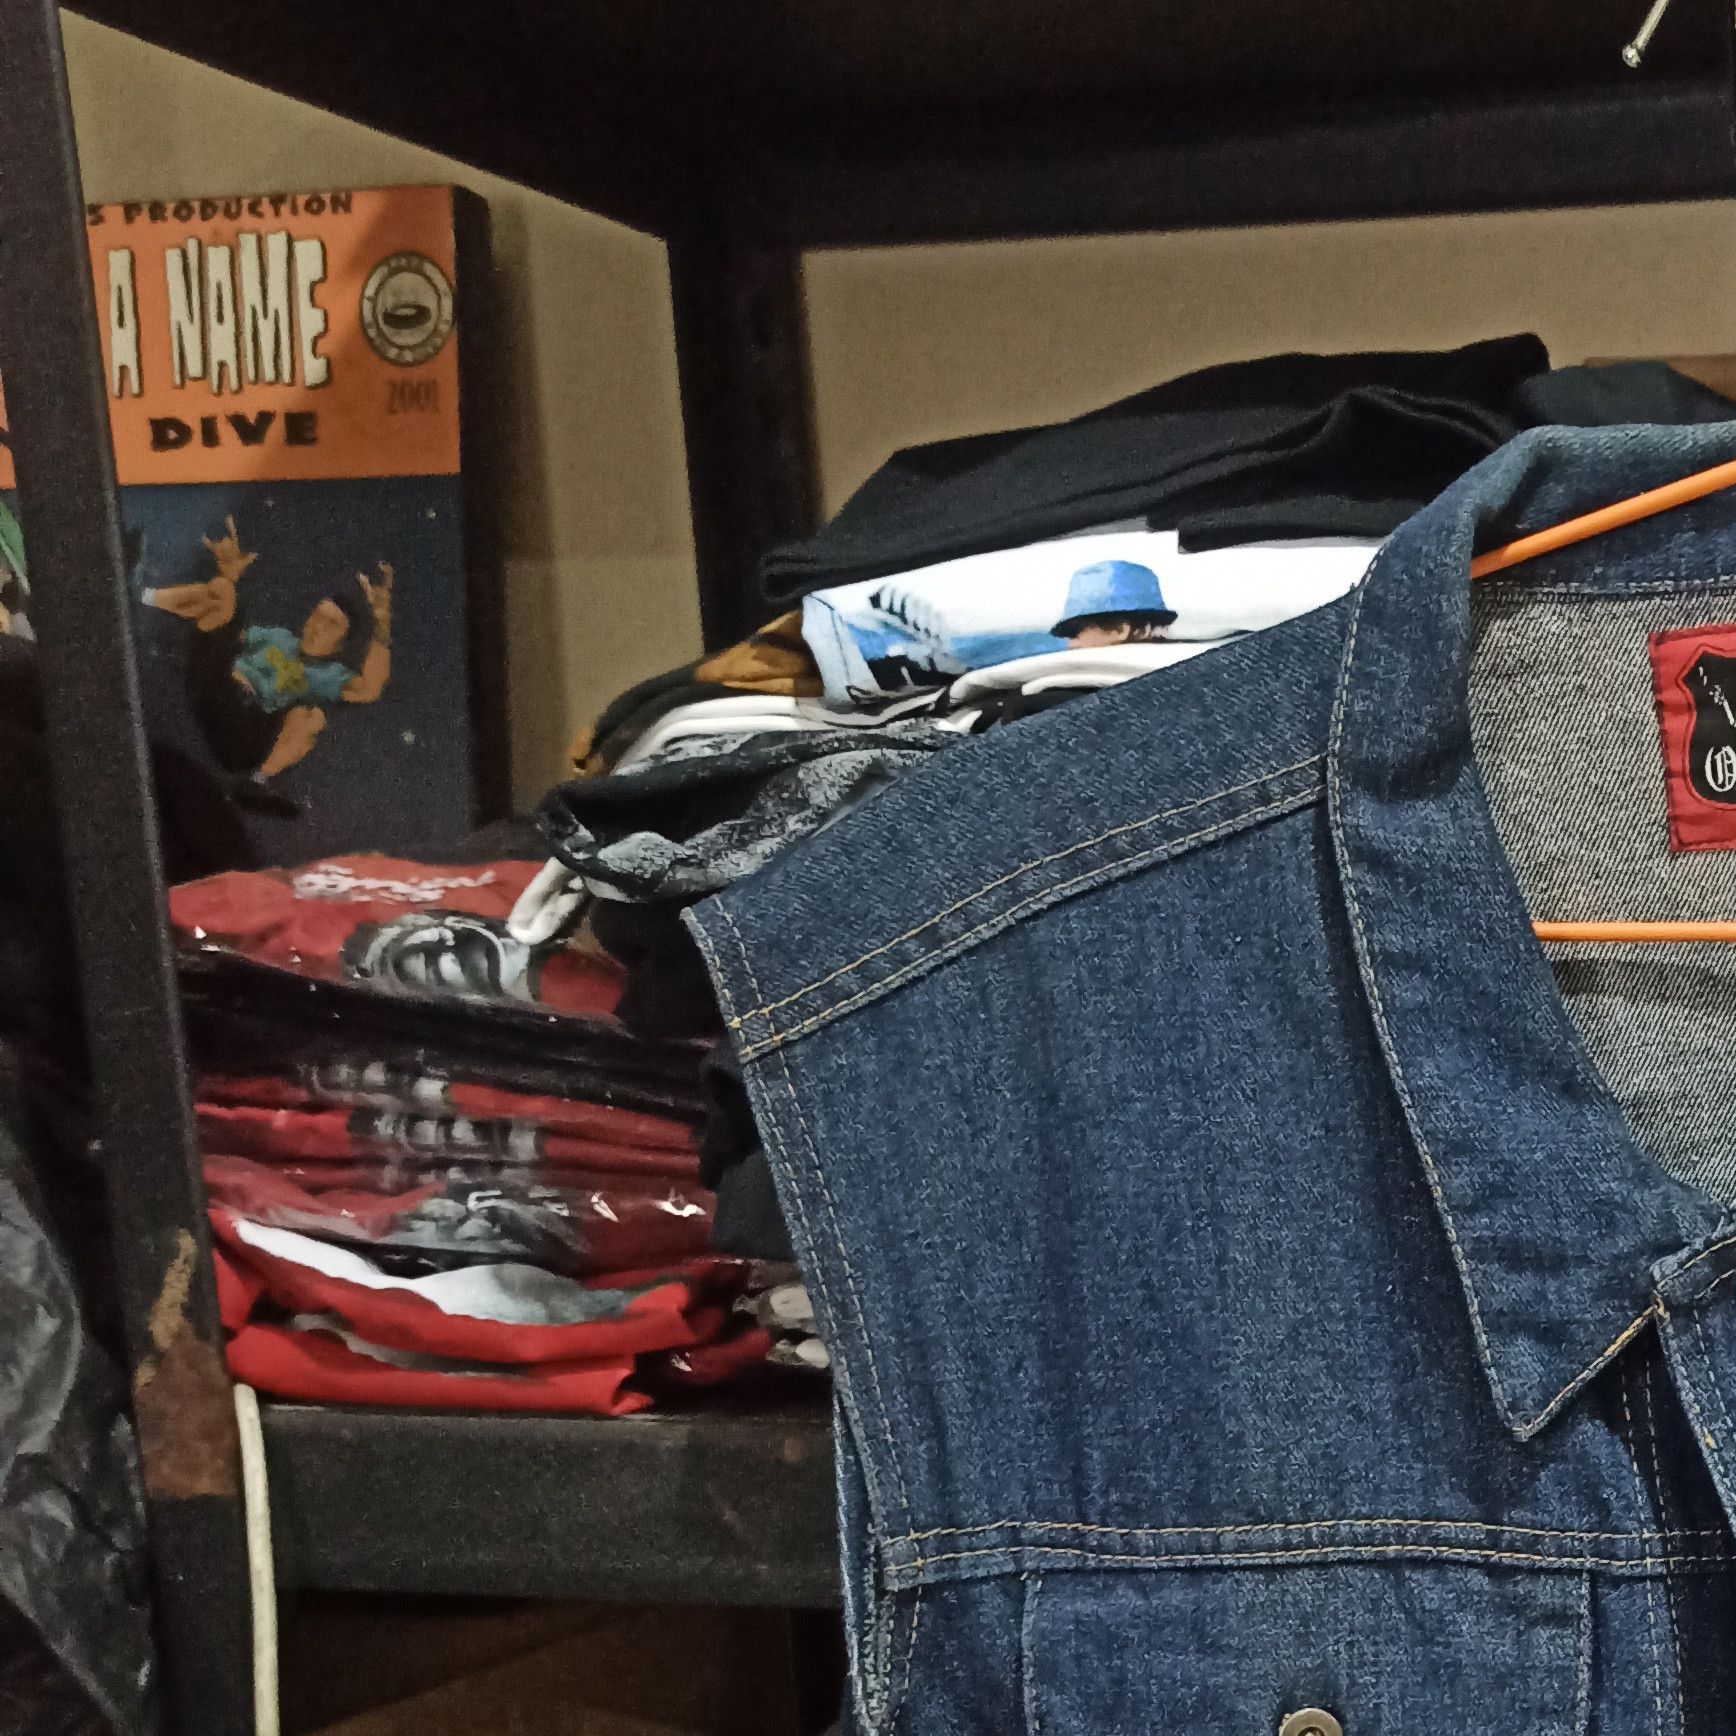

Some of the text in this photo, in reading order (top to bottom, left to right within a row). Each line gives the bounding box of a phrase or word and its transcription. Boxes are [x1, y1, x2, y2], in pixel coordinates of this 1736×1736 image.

[124, 188, 352, 225] PRODUCTION
[109, 247, 142, 399] A
[165, 230, 330, 396] NAME
[149, 410, 318, 452] DIVE
